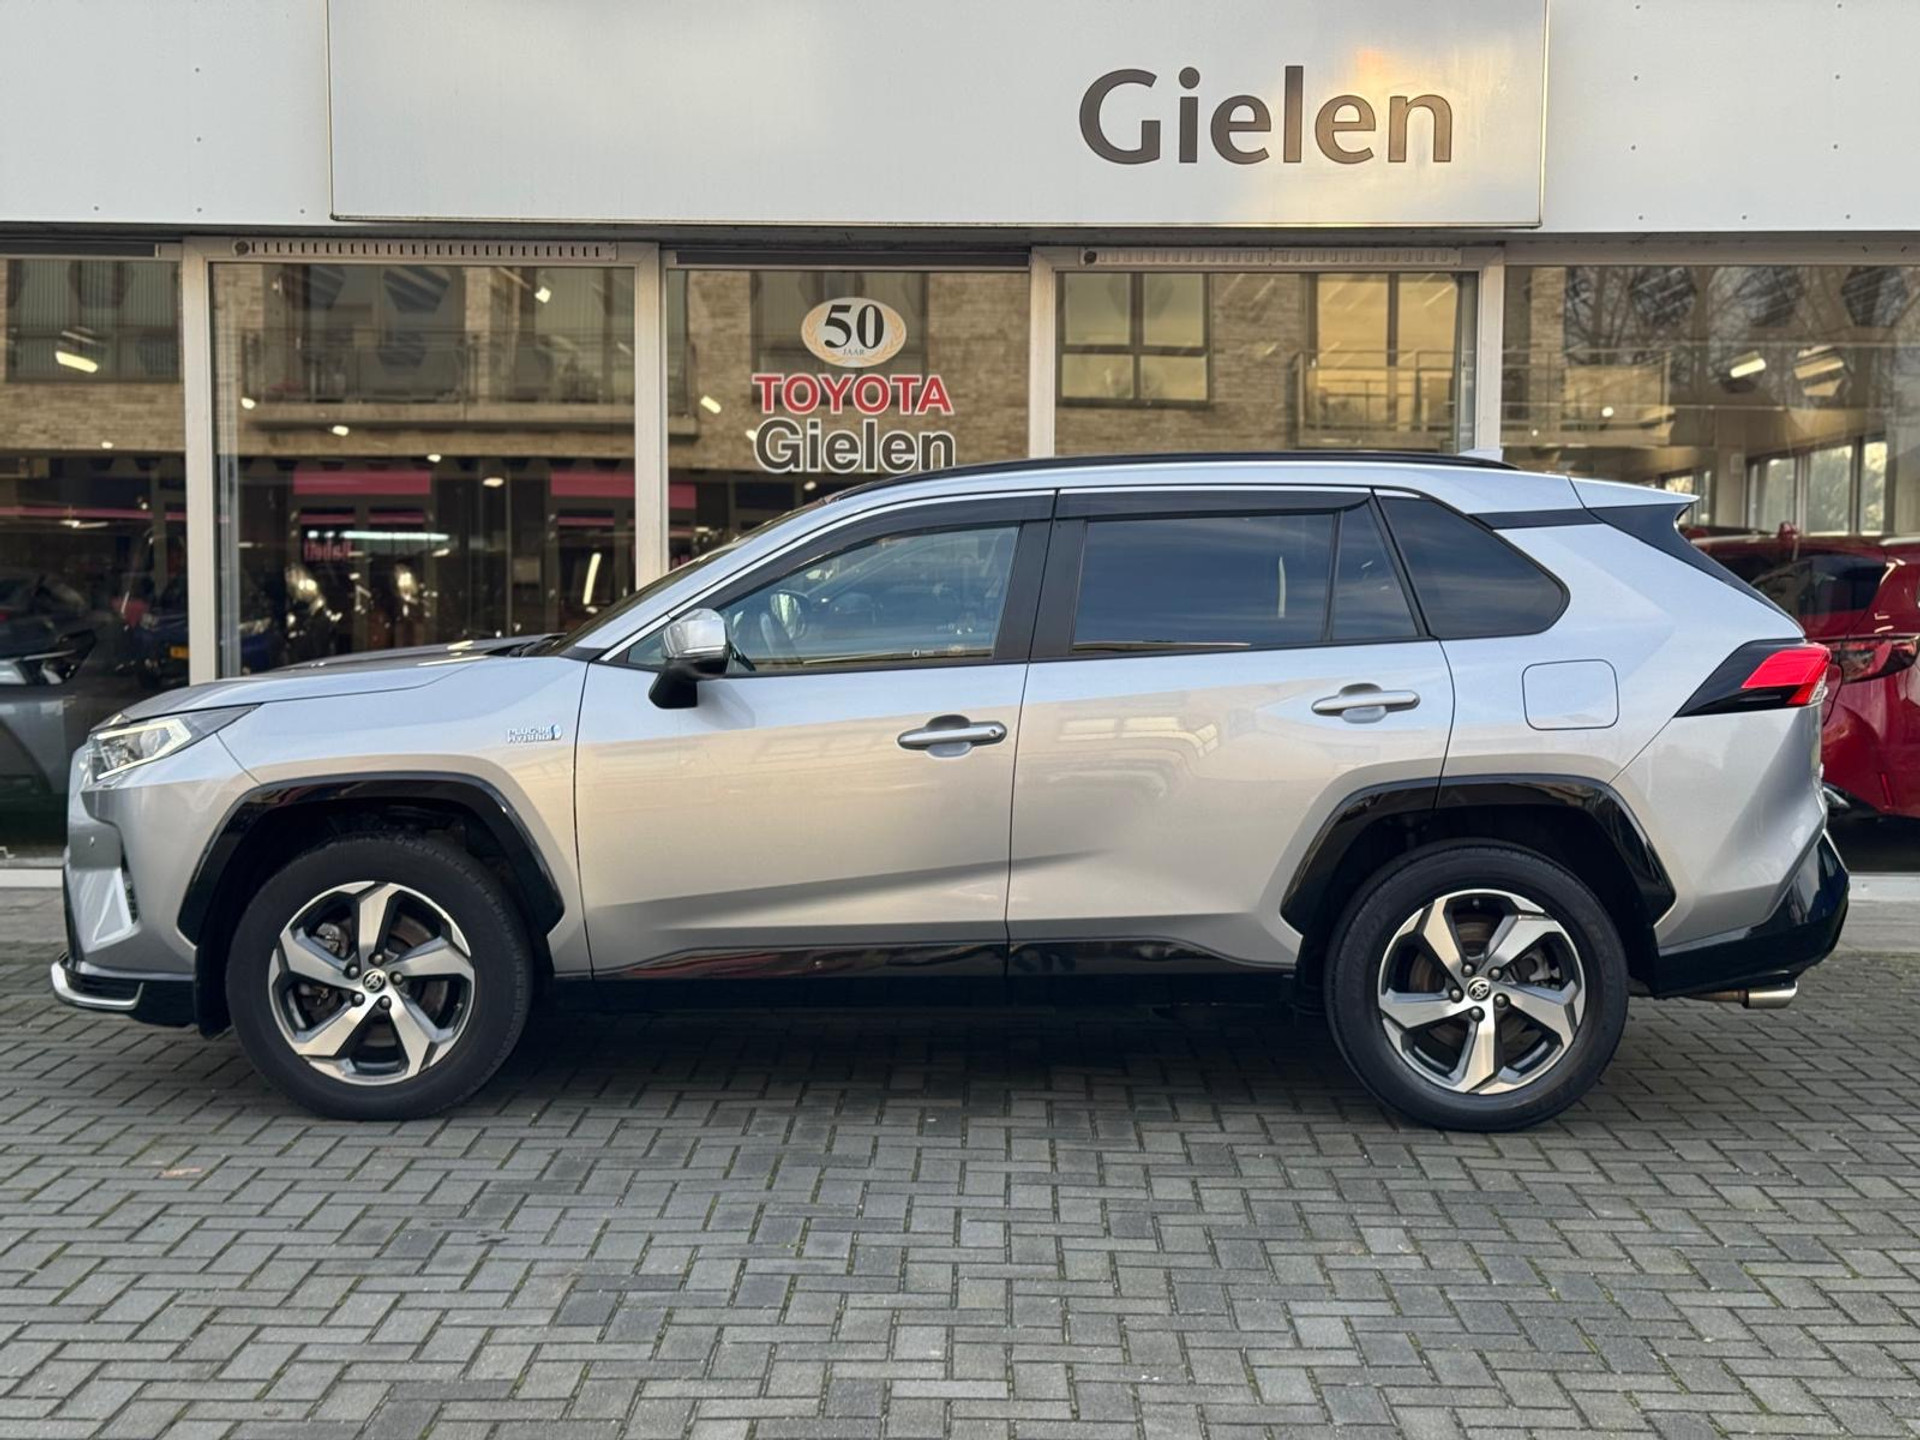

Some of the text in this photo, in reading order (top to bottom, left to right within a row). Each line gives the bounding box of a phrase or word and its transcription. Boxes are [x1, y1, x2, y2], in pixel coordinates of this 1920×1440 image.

[1079, 65, 1453, 165] Gielen
[824, 303, 885, 349] 50
[752, 373, 955, 416] TOYOTA
[754, 416, 956, 473] Gielen
